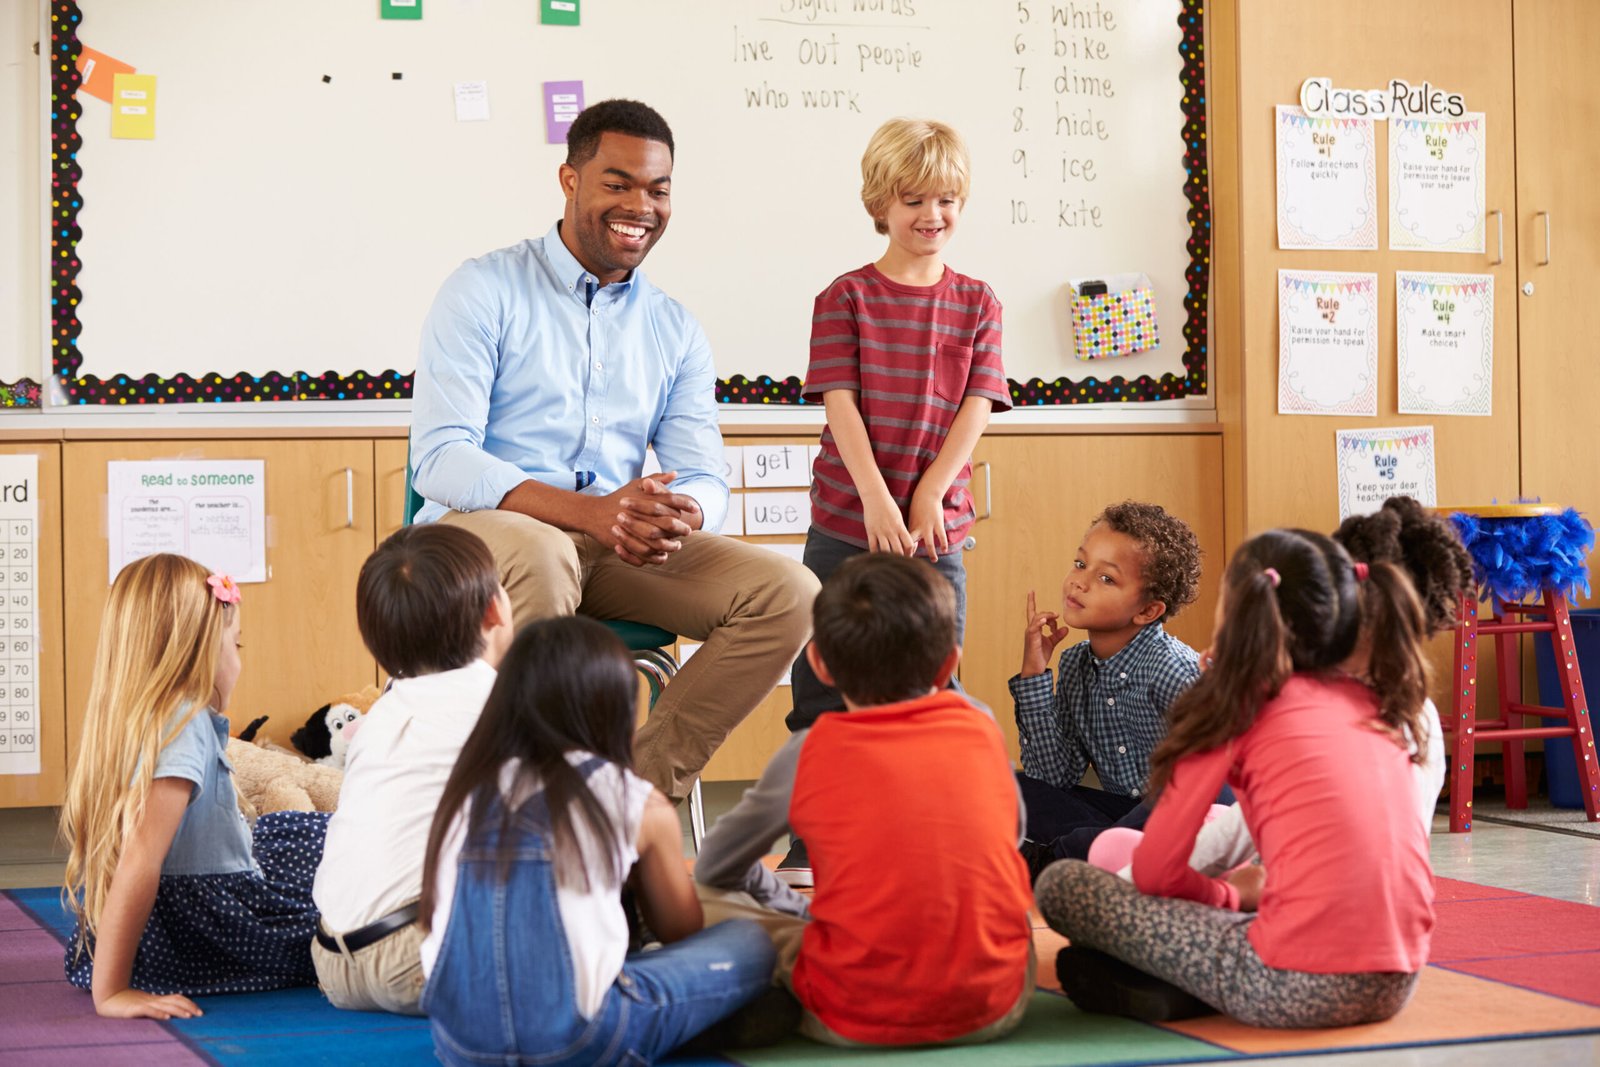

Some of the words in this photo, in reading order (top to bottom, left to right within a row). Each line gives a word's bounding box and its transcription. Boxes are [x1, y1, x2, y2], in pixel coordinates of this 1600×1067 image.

[1051, 2, 1117, 31] white
[734, 25, 773, 62] live
[858, 42, 921, 72] people
[1053, 28, 1109, 60] bike
[1054, 66, 1115, 98] dime
[745, 80, 789, 108] who
[801, 89, 861, 113] work
[1306, 81, 1385, 116] Class
[1392, 80, 1464, 116] Rules
[1055, 101, 1109, 140] hide
[1312, 133, 1335, 145] Rule
[1425, 134, 1447, 147] Rule
[1062, 150, 1096, 182] ice
[1291, 159, 1314, 168] Follow
[1318, 159, 1358, 169] directions
[1403, 162, 1422, 171] Raise
[1424, 165, 1439, 173] your
[1441, 164, 1458, 172] hand
[1460, 165, 1470, 173] for
[1311, 171, 1338, 180] quickly
[1403, 172, 1438, 180] permission
[1441, 173, 1449, 181] to
[1450, 173, 1471, 181] leave
[1420, 182, 1434, 190] your
[1438, 182, 1454, 190] seat
[1058, 199, 1103, 228] kite
[1316, 296, 1340, 310] Rule
[1432, 299, 1455, 312] Rule
[1292, 325, 1312, 334] Raise
[1334, 327, 1351, 335] hand
[1354, 328, 1365, 336] for
[1422, 329, 1441, 337] Make
[1445, 329, 1466, 337] smart
[1292, 336, 1330, 345] permission
[1333, 337, 1340, 345] to
[1344, 338, 1365, 347] speak
[1430, 339, 1458, 348] choices
[756, 446, 792, 478] get
[1374, 455, 1398, 468] Rule
[141, 473, 173, 487] Read
[176, 476, 188, 485] to
[0, 478, 28, 502] rd
[1356, 482, 1377, 492] Keep
[1380, 483, 1397, 492] your
[1400, 482, 1418, 490] dear
[754, 504, 799, 524] use
[15, 525, 28, 536] 10
[13, 548, 28, 559] 20
[13, 571, 28, 582] 30
[12, 595, 28, 606] 40
[14, 618, 28, 629] 50
[14, 641, 29, 652] 60
[14, 664, 29, 675] 70
[15, 687, 29, 698] 80
[15, 711, 30, 721] 90
[13, 734, 34, 744] 100
